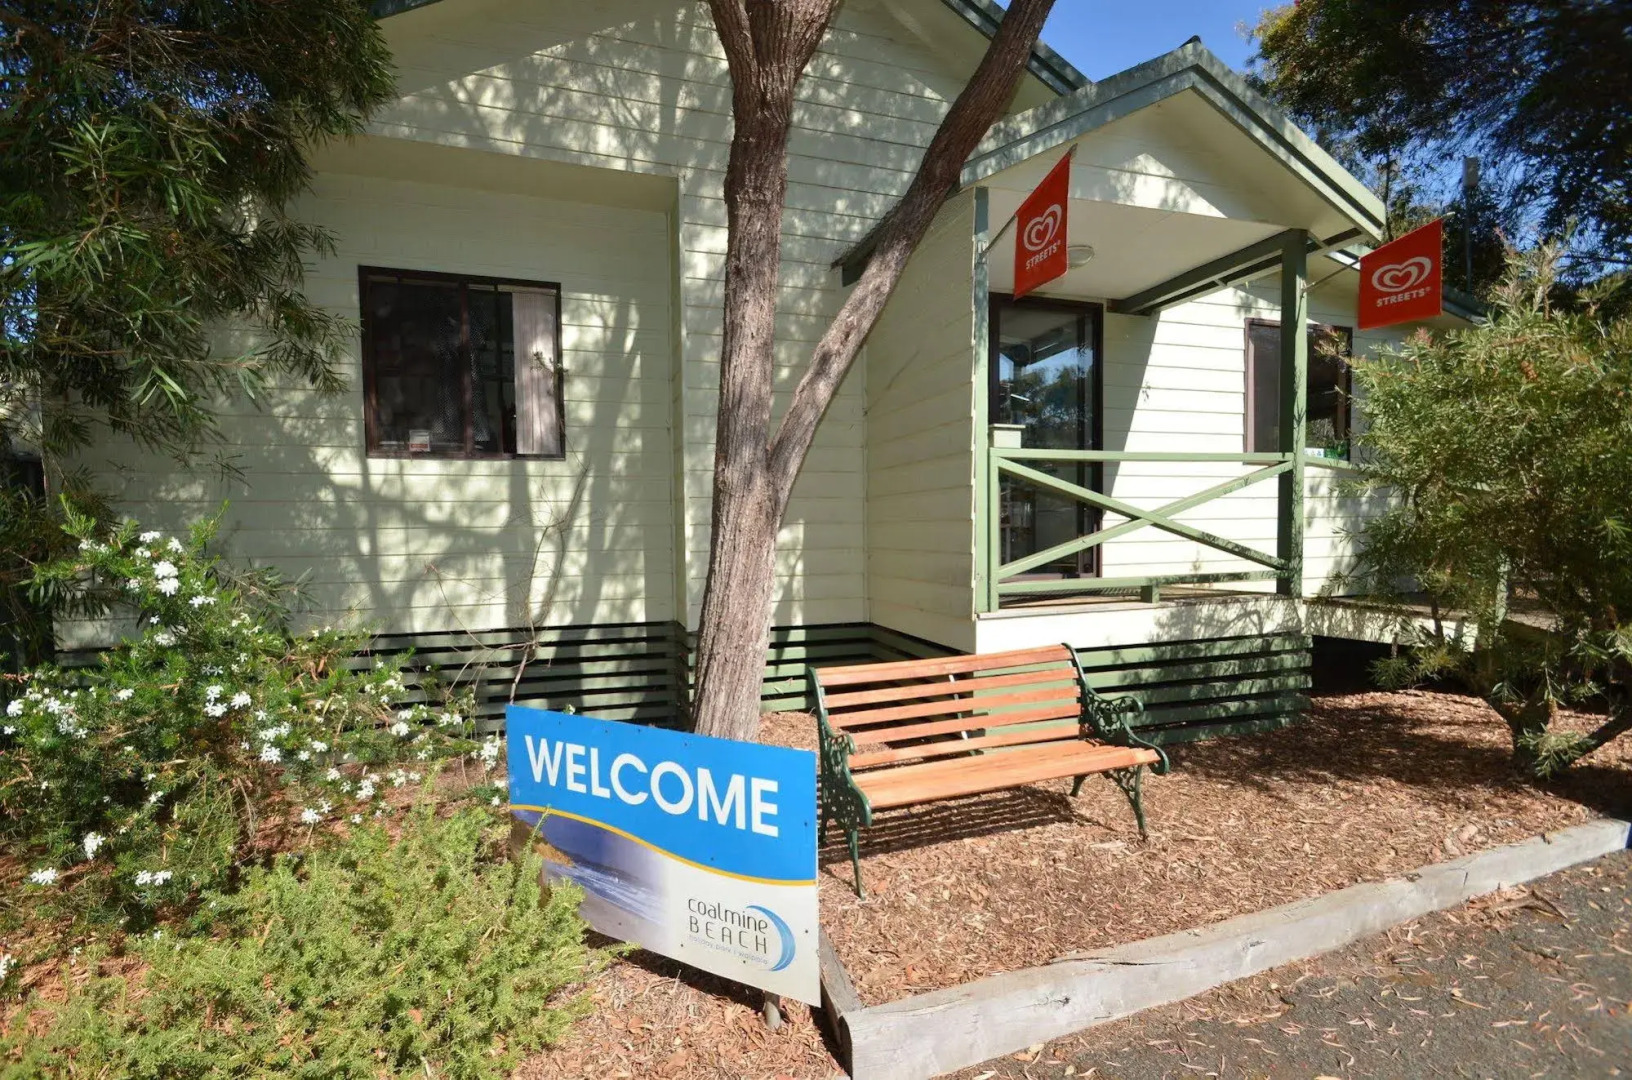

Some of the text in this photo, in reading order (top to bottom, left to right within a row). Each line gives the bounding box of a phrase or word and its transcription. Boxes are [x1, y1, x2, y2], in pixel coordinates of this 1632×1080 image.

[1026, 245, 1058, 270] STREETS
[1376, 288, 1425, 307] STREETS
[524, 735, 779, 838] WELCOME
[689, 915, 767, 954] BEACH
